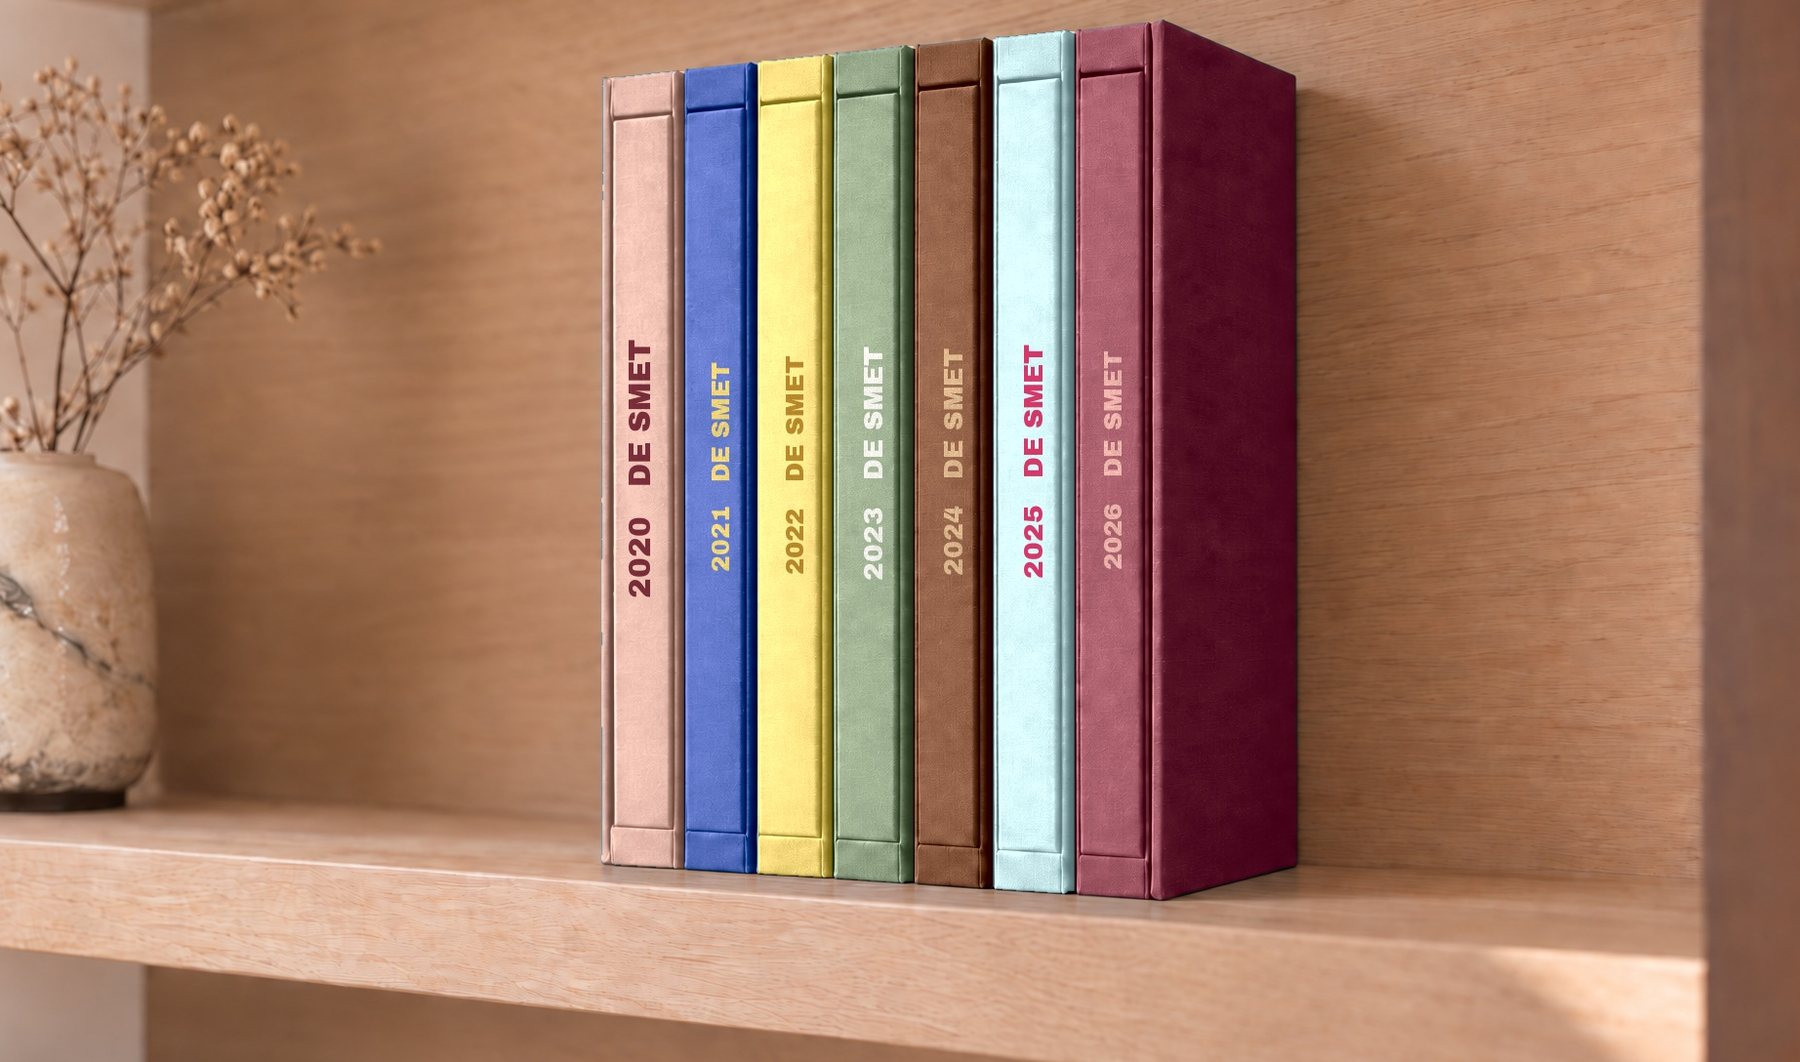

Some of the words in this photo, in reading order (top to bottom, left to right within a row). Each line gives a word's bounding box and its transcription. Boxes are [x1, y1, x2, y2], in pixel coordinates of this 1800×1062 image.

[628, 339, 651, 432] SMET
[711, 362, 731, 438] SMET
[785, 356, 804, 435] SMET
[863, 347, 883, 430] SMET
[943, 349, 963, 430] SMET
[1023, 345, 1043, 428] SMET
[1103, 351, 1122, 430] SMET
[628, 442, 651, 486] DE
[711, 446, 731, 482] DE
[785, 444, 804, 481] DE
[863, 440, 883, 479] DE
[943, 440, 963, 478] DE
[1023, 438, 1043, 477] DE
[1103, 440, 1122, 477] DE
[628, 518, 651, 598] 2020
[711, 507, 731, 572] 2021
[785, 508, 804, 575] 2022
[863, 508, 883, 581] 2023
[943, 506, 963, 576] 2024
[1023, 505, 1043, 579] 2025
[1103, 504, 1122, 570] 2026
